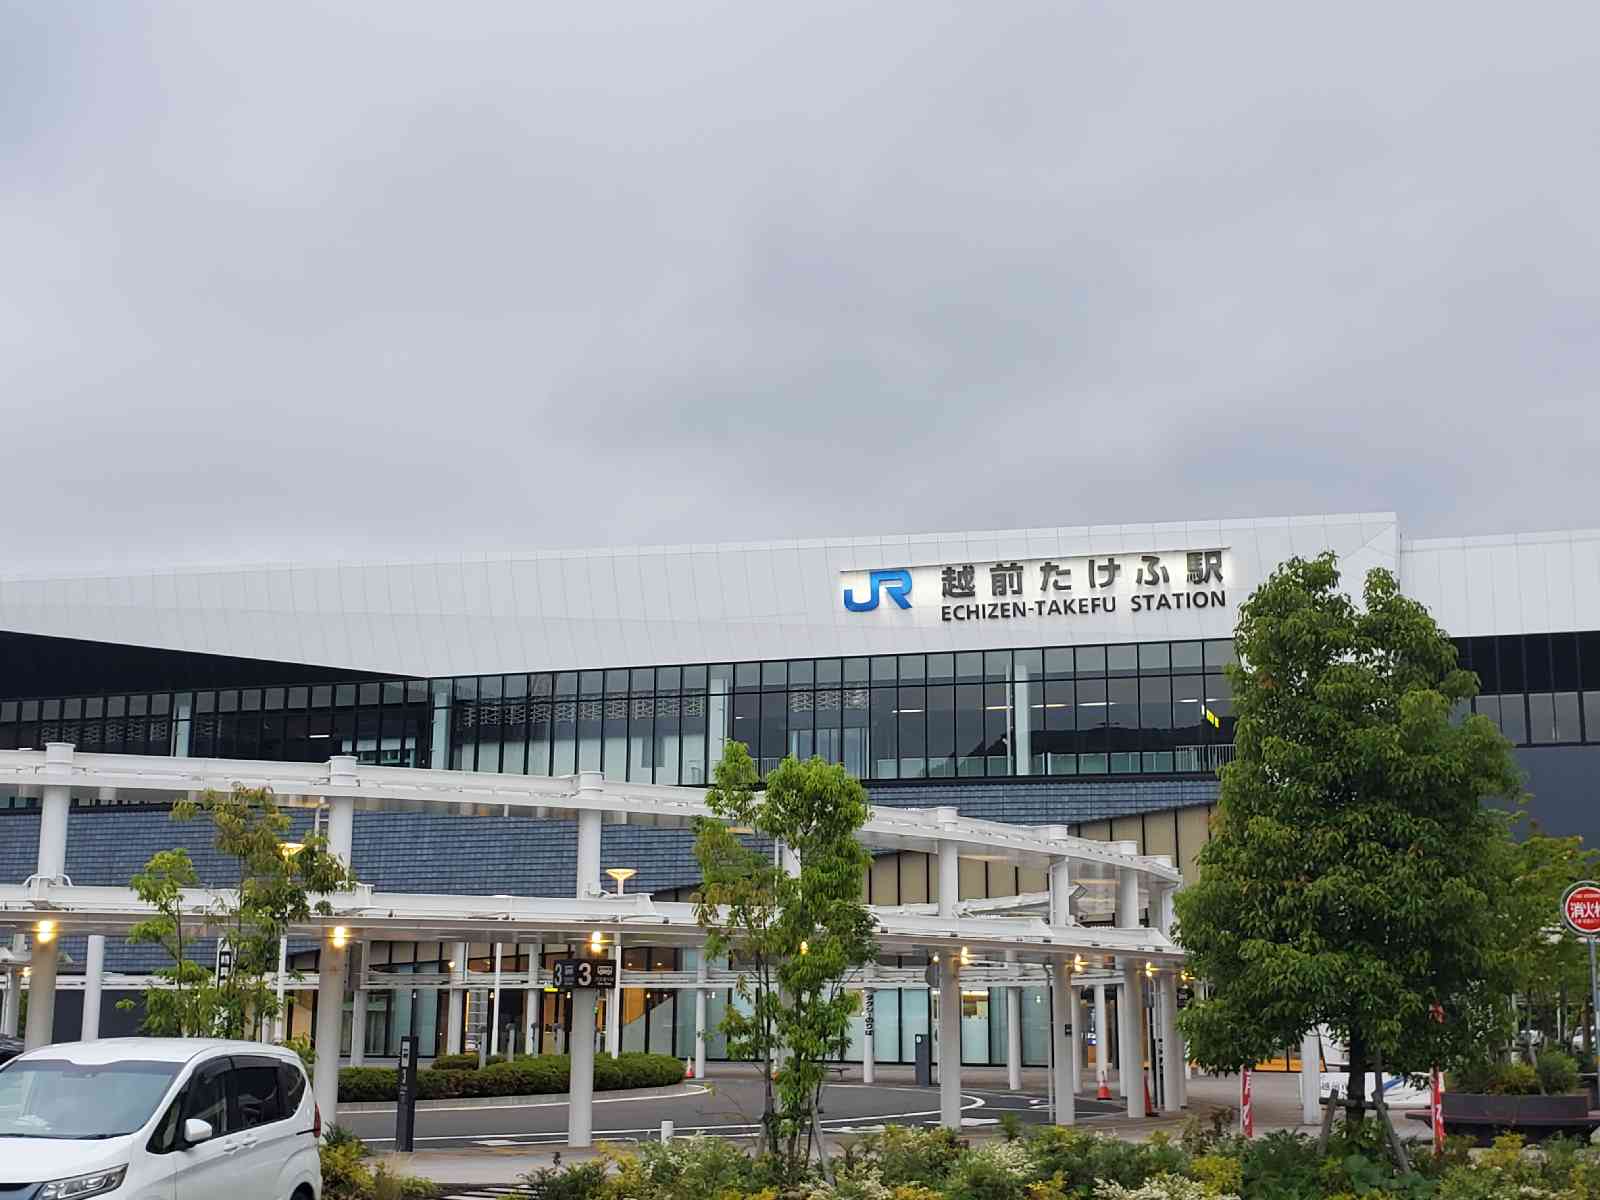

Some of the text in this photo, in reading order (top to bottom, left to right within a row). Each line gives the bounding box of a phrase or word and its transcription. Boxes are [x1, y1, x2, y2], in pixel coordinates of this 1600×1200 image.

[844, 568, 912, 612] JR
[941, 551, 1223, 598] 越前たけふ駅
[941, 590, 1226, 622] ECHIZEN-TAKEFU STATION
[578, 962, 592, 986] 3
